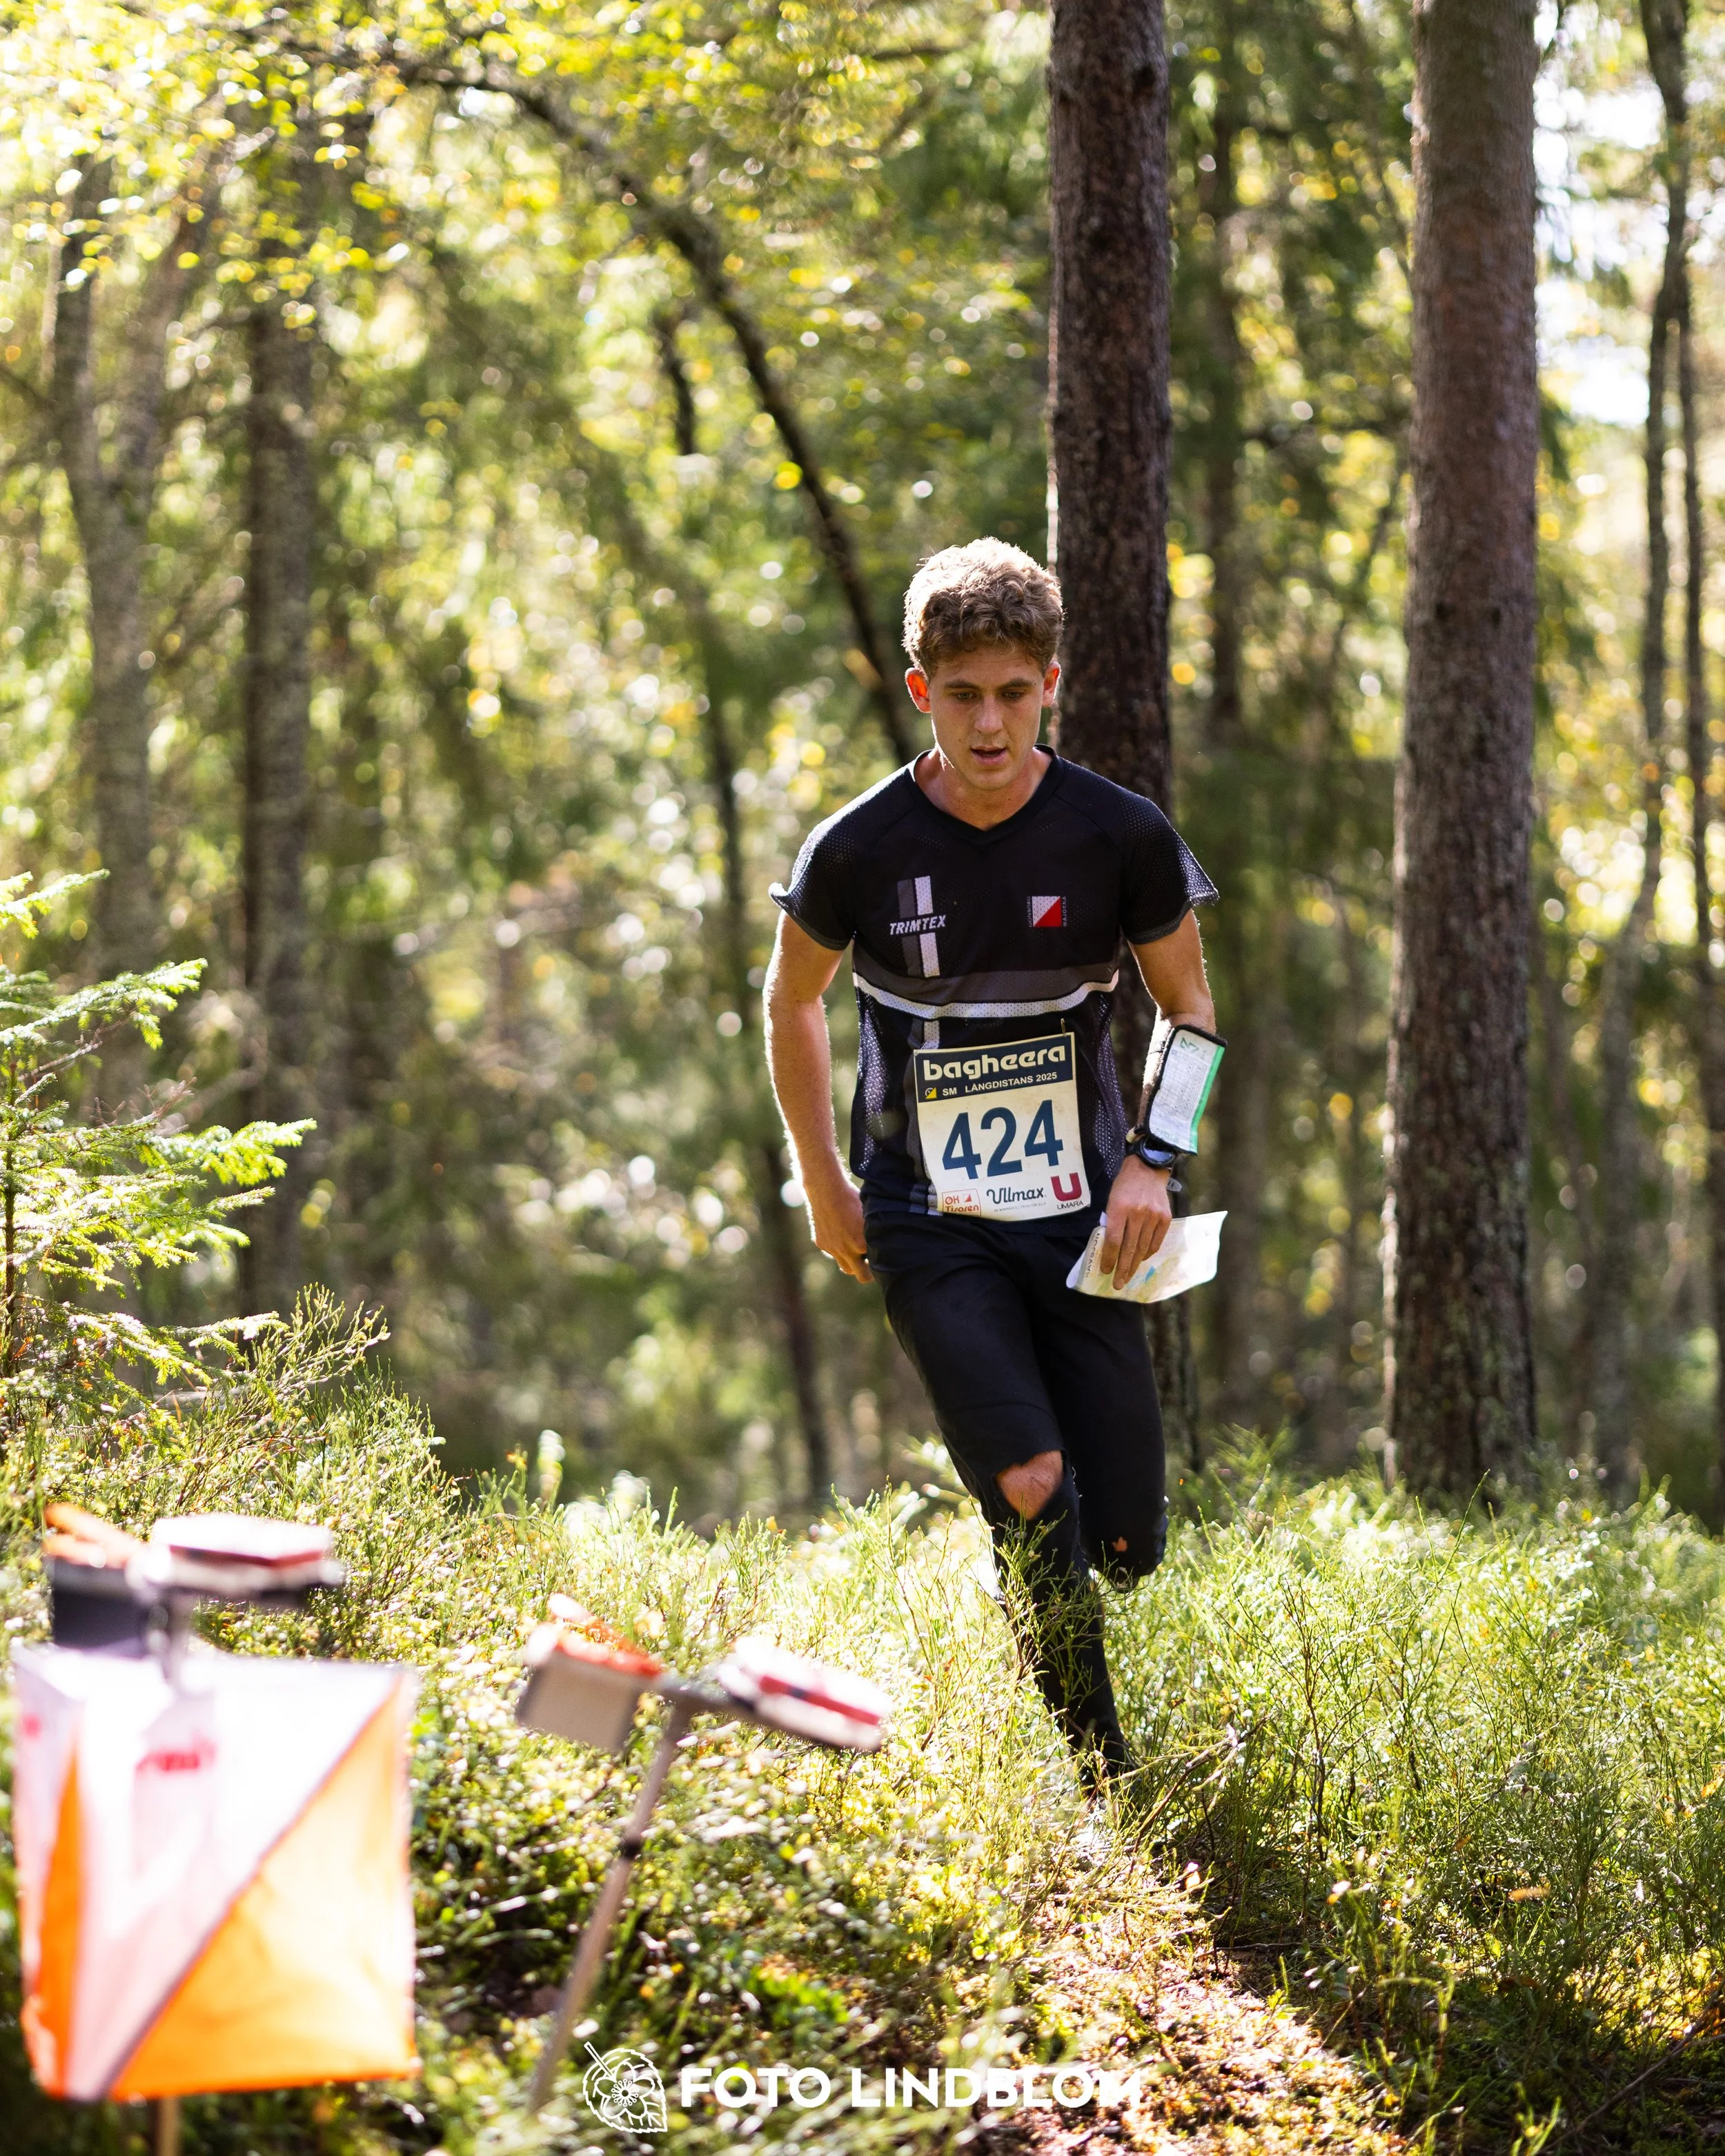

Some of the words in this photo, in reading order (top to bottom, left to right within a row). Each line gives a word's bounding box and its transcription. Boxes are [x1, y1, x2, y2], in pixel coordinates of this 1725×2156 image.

[889, 915, 946, 935] TRIMTEX
[923, 1045, 1065, 1080] bagheera
[943, 1087, 957, 1096] SM
[1036, 1071, 1058, 1082] 2025
[942, 1099, 1063, 1180] 424
[987, 1187, 1044, 1205] Ullmax
[1050, 1172, 1082, 1201] U
[1056, 1200, 1084, 1210] UMARA
